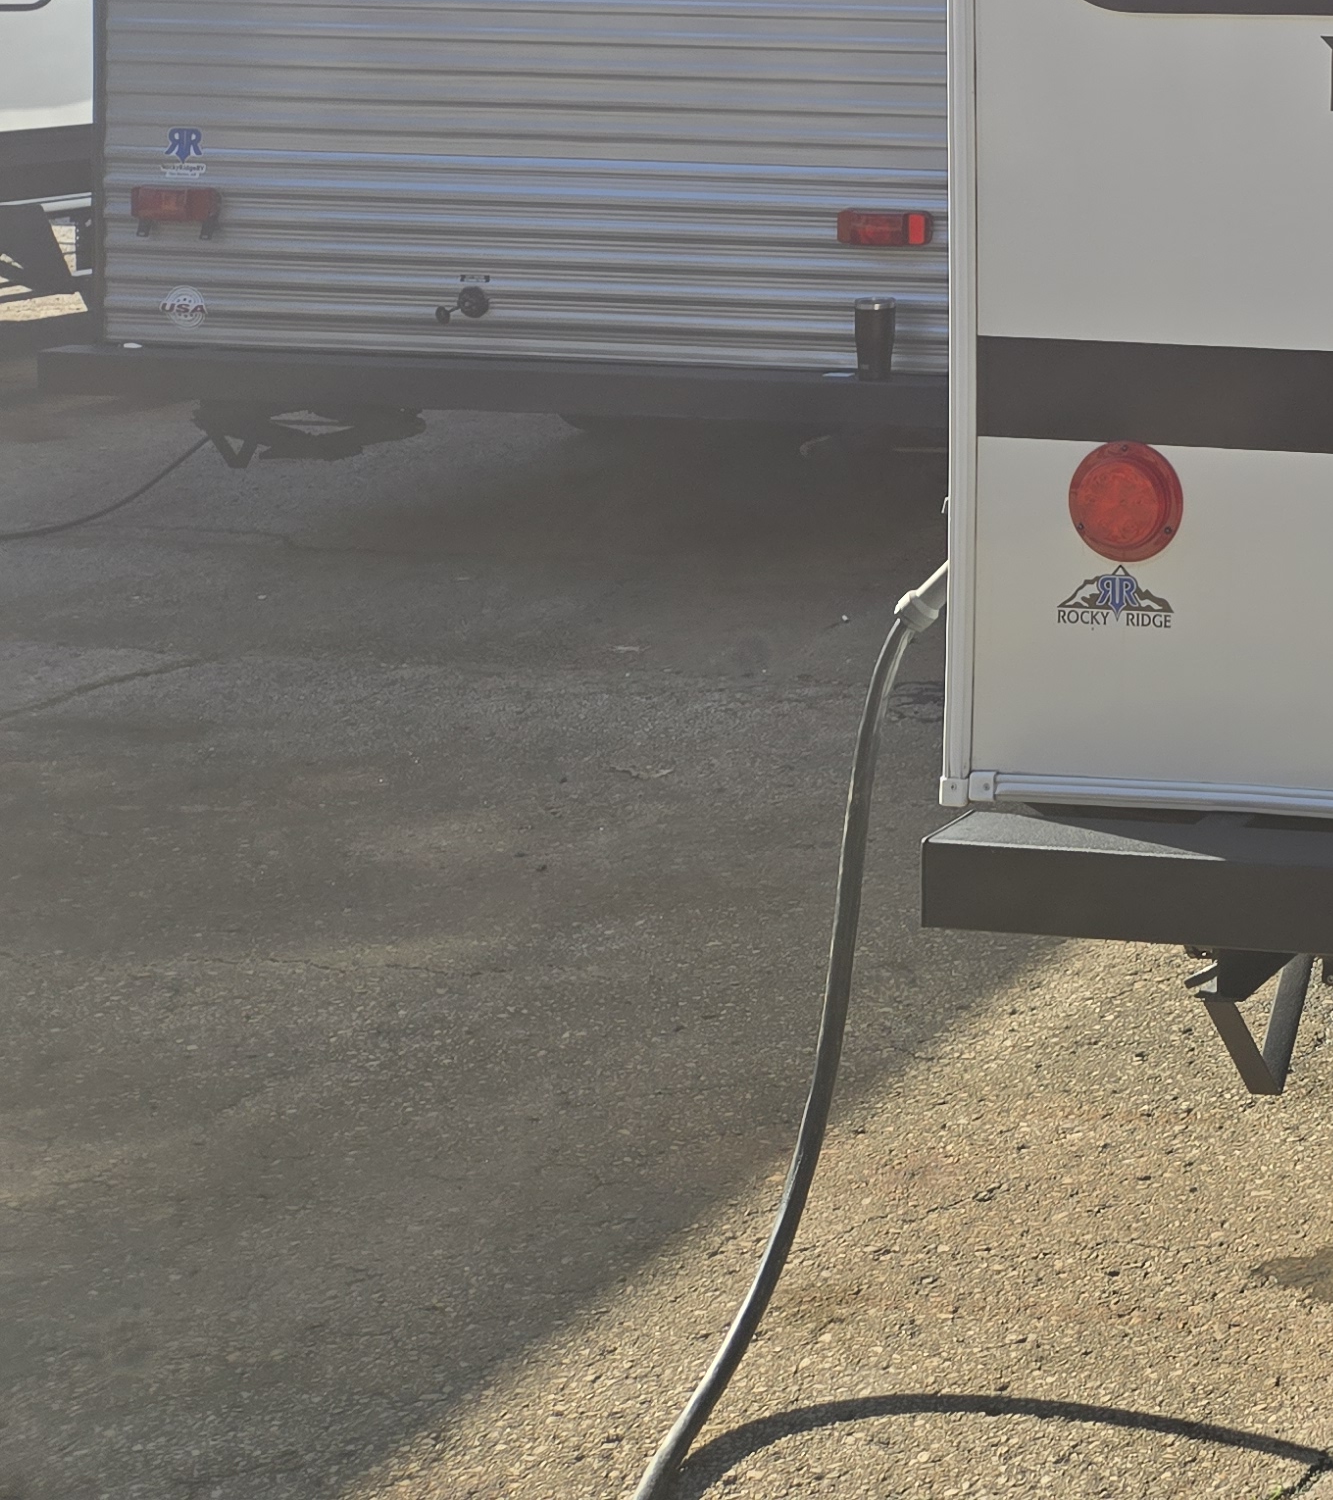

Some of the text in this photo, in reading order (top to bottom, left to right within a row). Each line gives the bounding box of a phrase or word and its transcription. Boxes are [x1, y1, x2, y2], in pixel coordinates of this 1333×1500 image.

[161, 303, 206, 313] USA
[1057, 610, 1171, 628] ROCKY RIDGE
